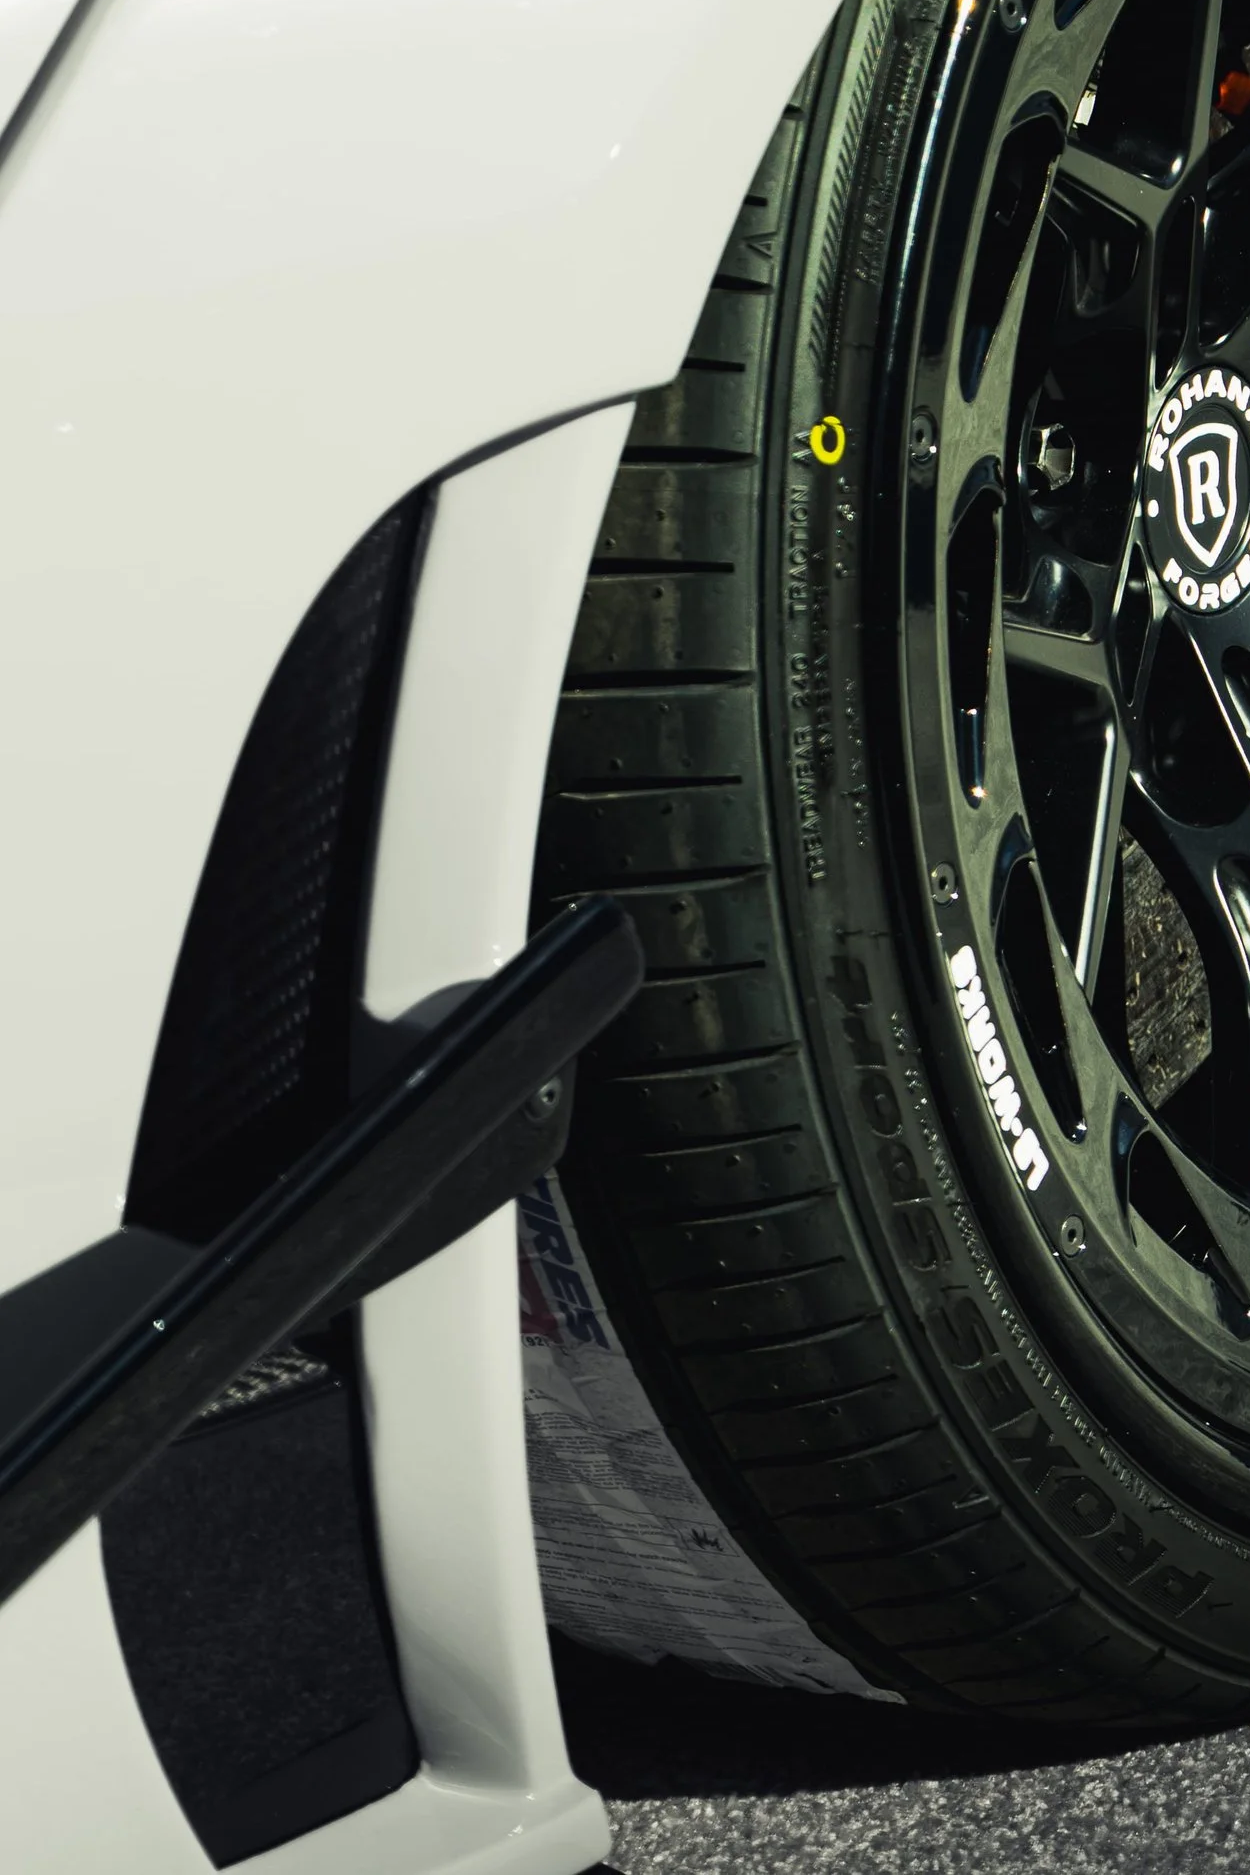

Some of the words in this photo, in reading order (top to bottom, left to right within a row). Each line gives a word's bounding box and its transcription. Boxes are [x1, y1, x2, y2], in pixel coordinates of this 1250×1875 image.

[790, 427, 812, 466] AA
[1187, 450, 1226, 525] R
[787, 484, 809, 619] TRACTION
[789, 652, 811, 710] 240
[793, 724, 825, 886] TREADWEAR
[828, 946, 956, 1273] Sport
[941, 1295, 1216, 1620] PROXES
